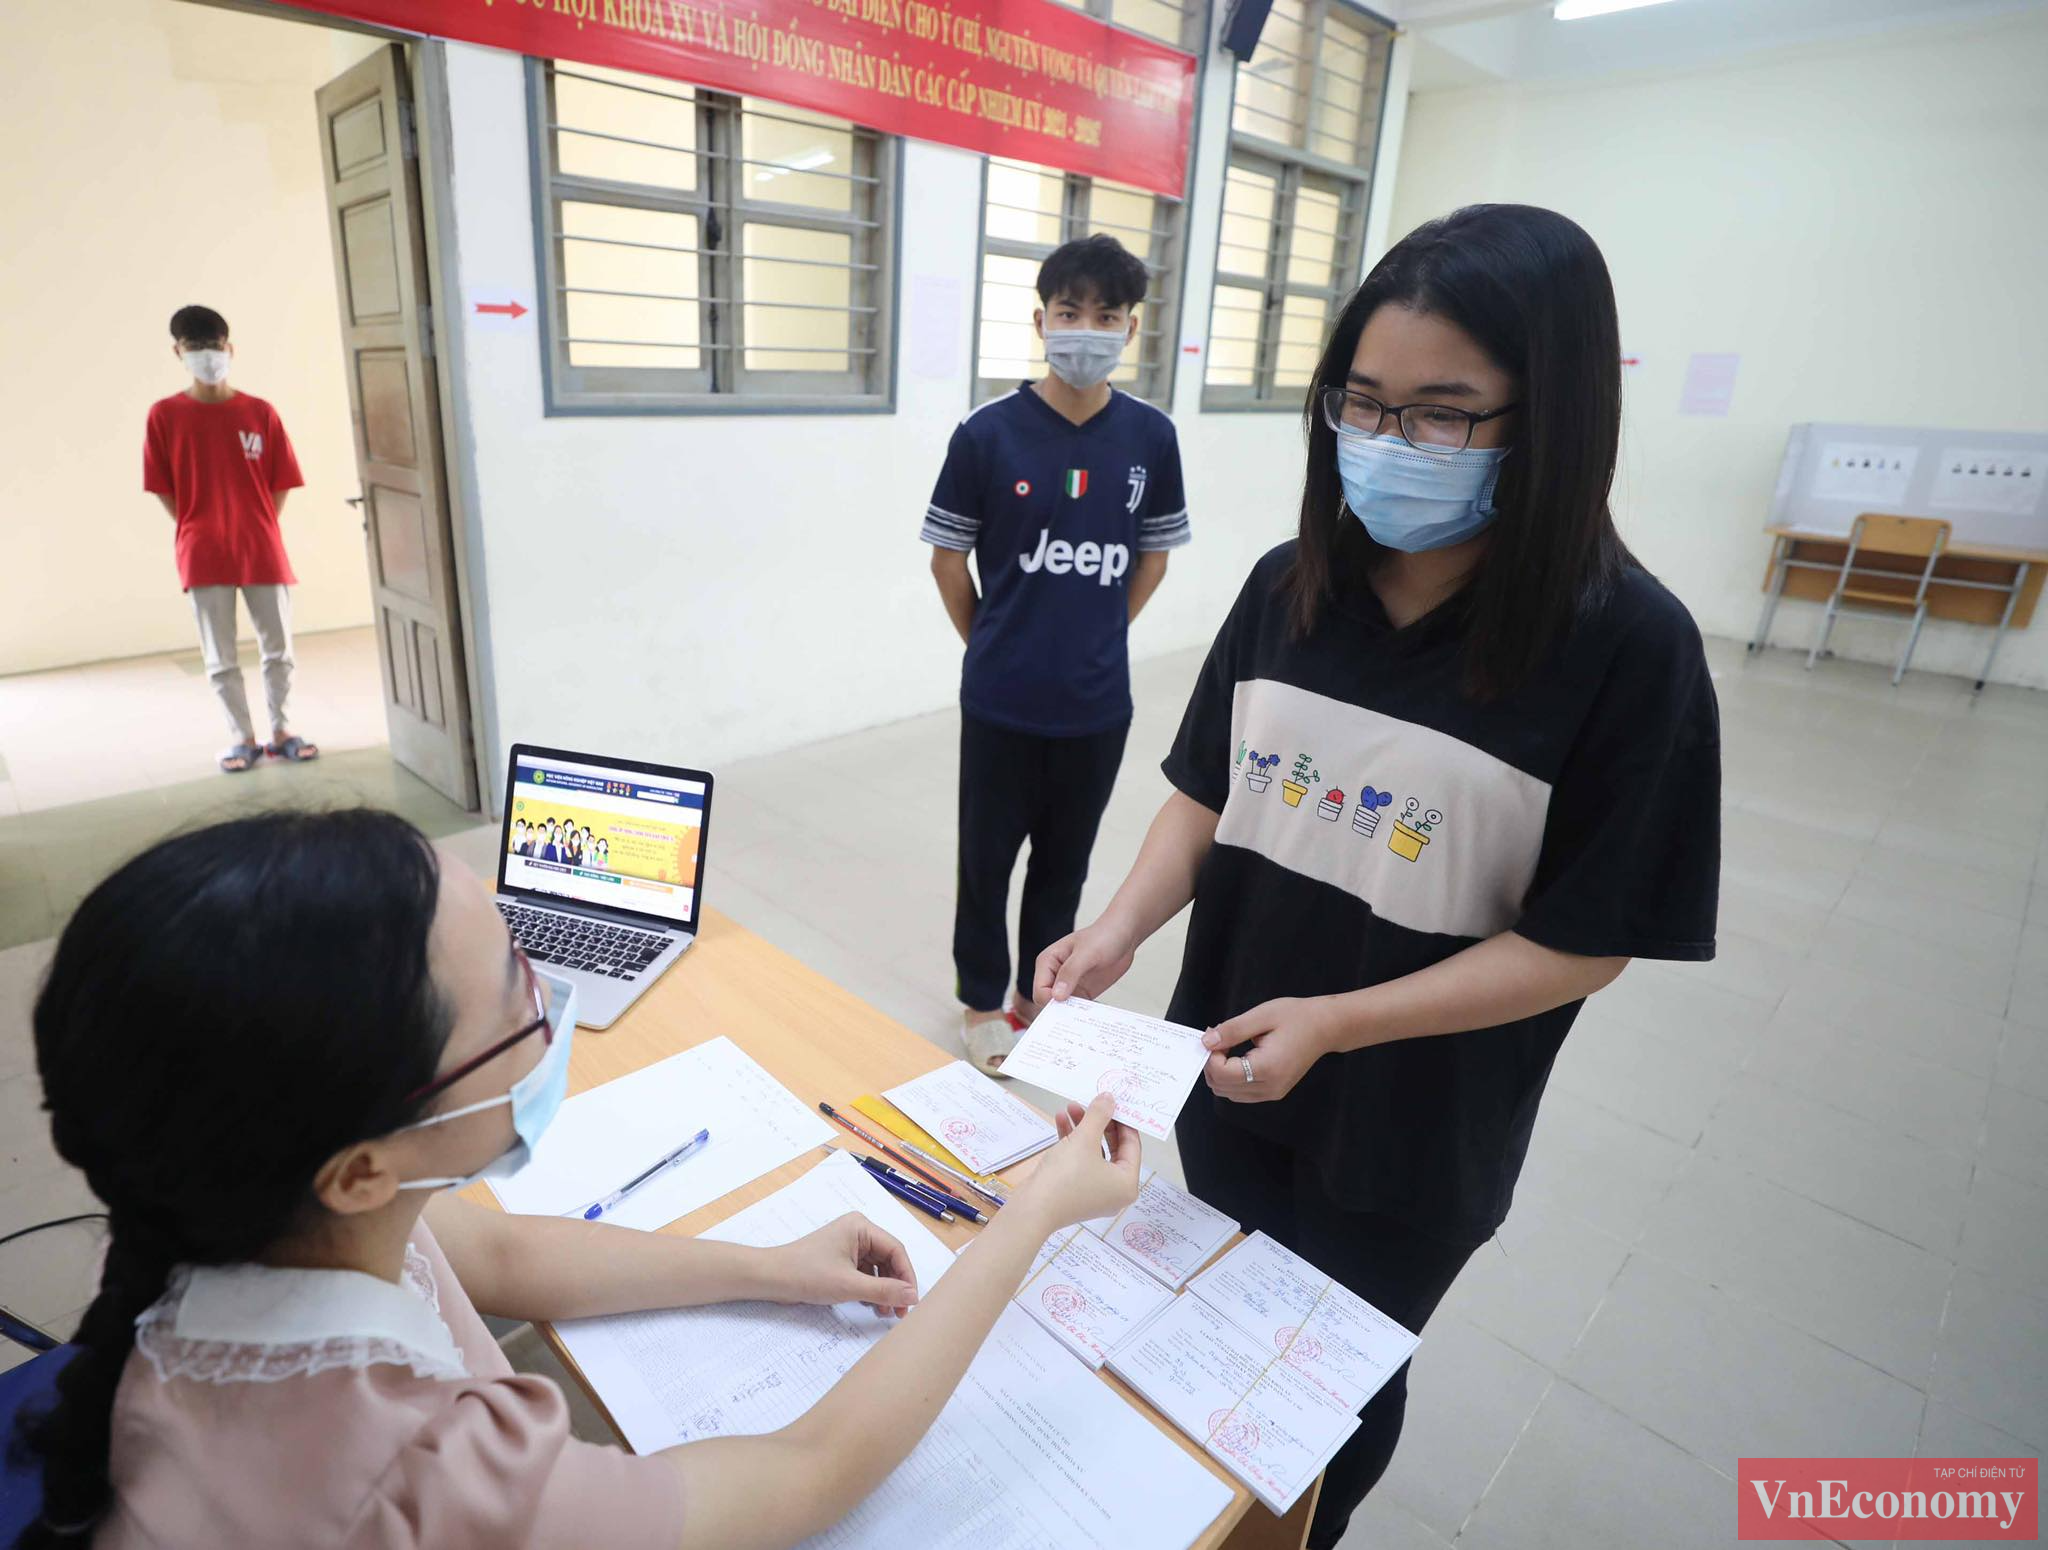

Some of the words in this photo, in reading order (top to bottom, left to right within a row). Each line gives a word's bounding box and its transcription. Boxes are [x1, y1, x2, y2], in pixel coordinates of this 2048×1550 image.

[905, 0, 939, 42] CHO
[702, 2, 730, 54] VÀ
[734, 10, 769, 72] HỘI
[915, 61, 946, 107] CÁC
[946, 67, 977, 115] CẤP
[1019, 528, 1130, 586] Jeep
